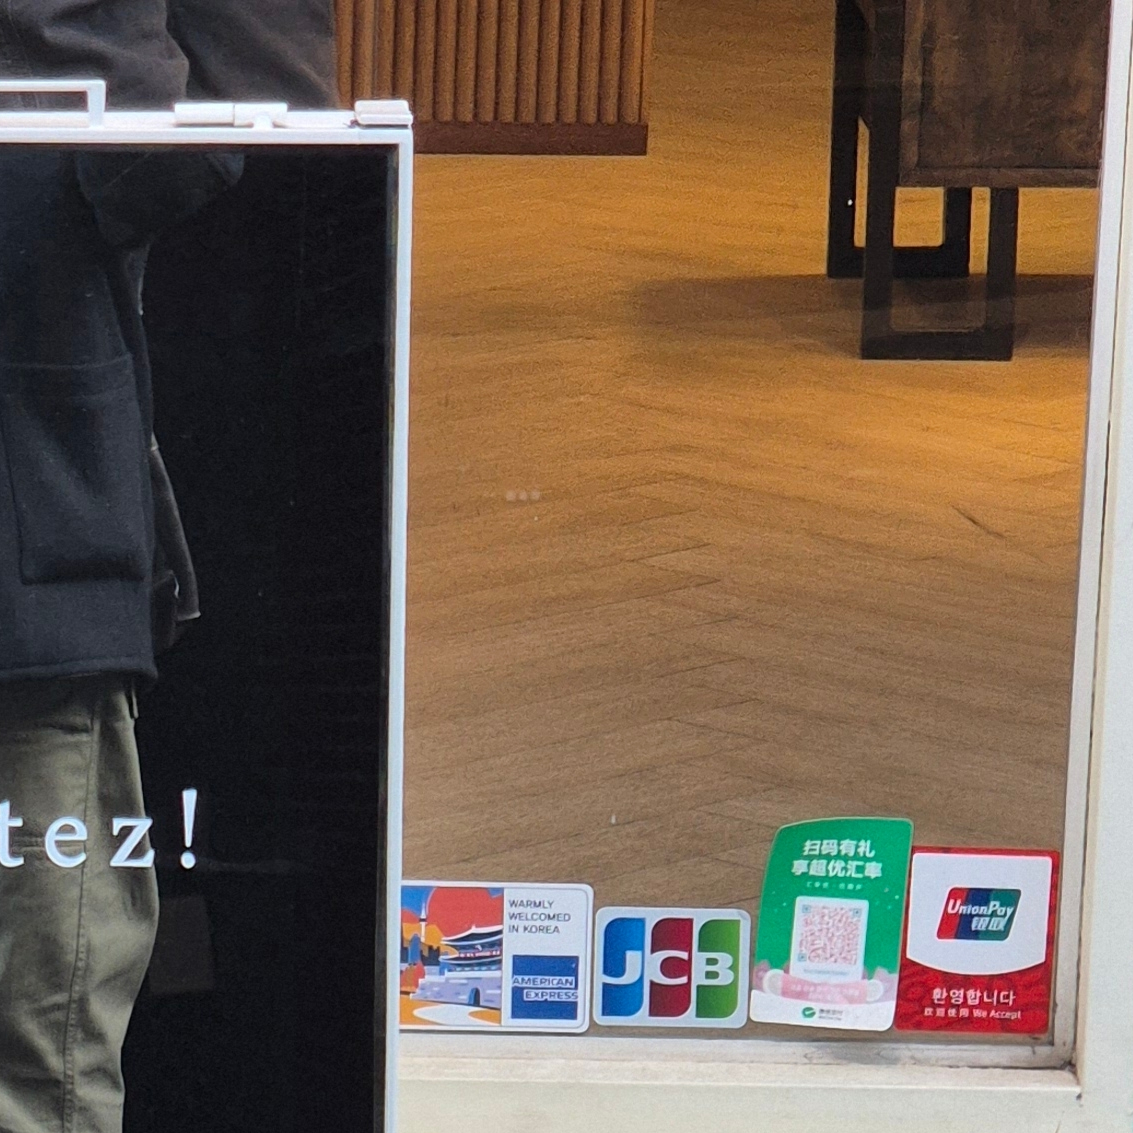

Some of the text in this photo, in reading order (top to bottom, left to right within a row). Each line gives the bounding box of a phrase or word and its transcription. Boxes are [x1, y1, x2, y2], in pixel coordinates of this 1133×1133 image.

[803, 838, 876, 858] 扫码有礼
[508, 899, 555, 909] WARMLY
[947, 898, 1015, 918] UnionPay
[508, 912, 571, 922] WELCOMED
[508, 924, 561, 934] IN KOREA
[600, 949, 735, 986] JCB
[512, 977, 574, 987] AMERICAN
[525, 990, 579, 1000] EXPRESS
[932, 987, 1016, 1006] 환영합니다
[972, 1008, 987, 1018] We
[989, 1009, 1022, 1020] Accept
